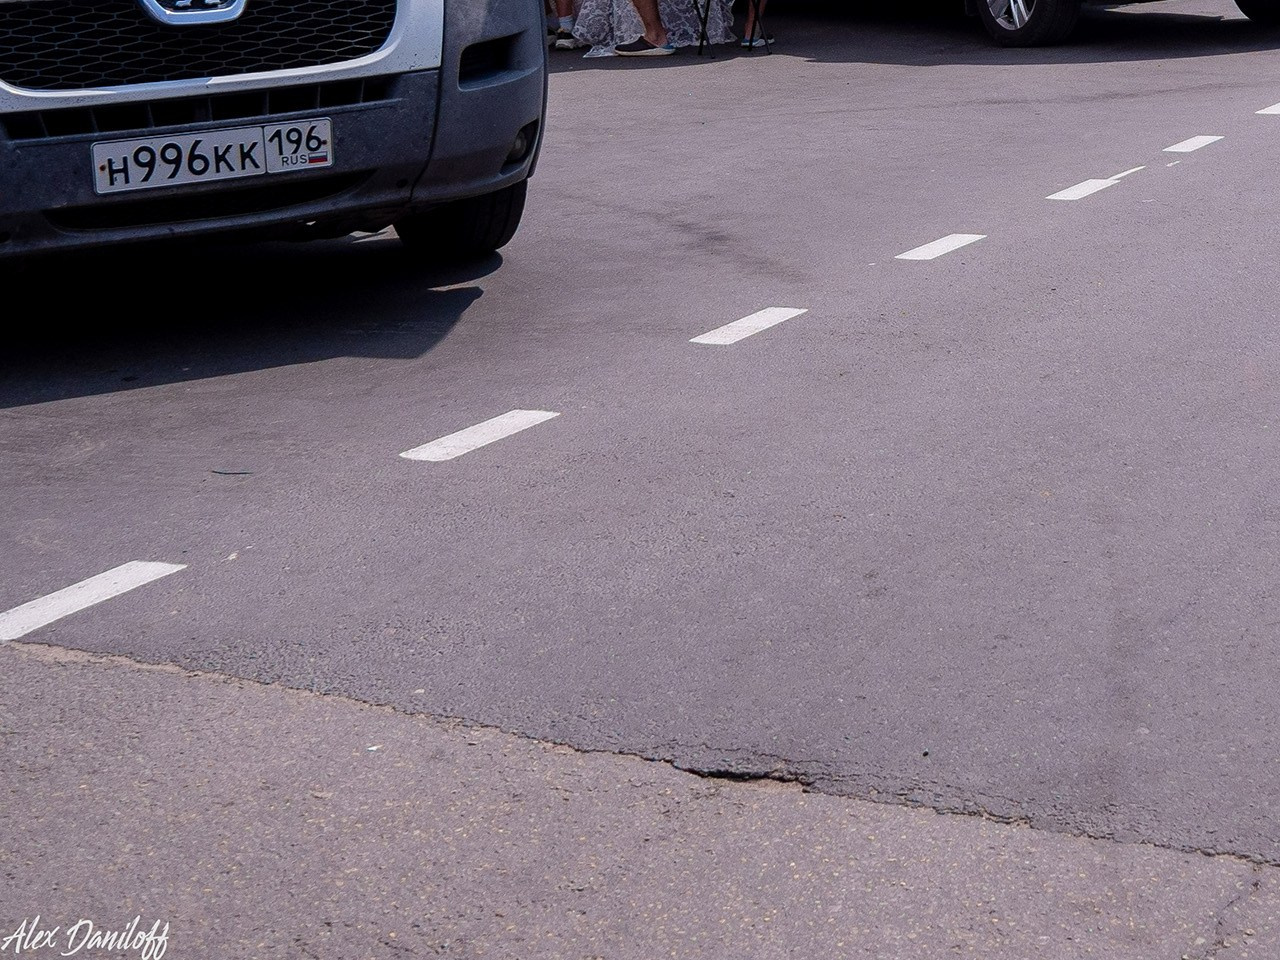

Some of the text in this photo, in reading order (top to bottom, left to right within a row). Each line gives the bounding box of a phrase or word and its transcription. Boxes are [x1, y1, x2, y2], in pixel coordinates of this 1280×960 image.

[107, 125, 322, 186] Н996КК 196
[282, 153, 308, 167] RUS
